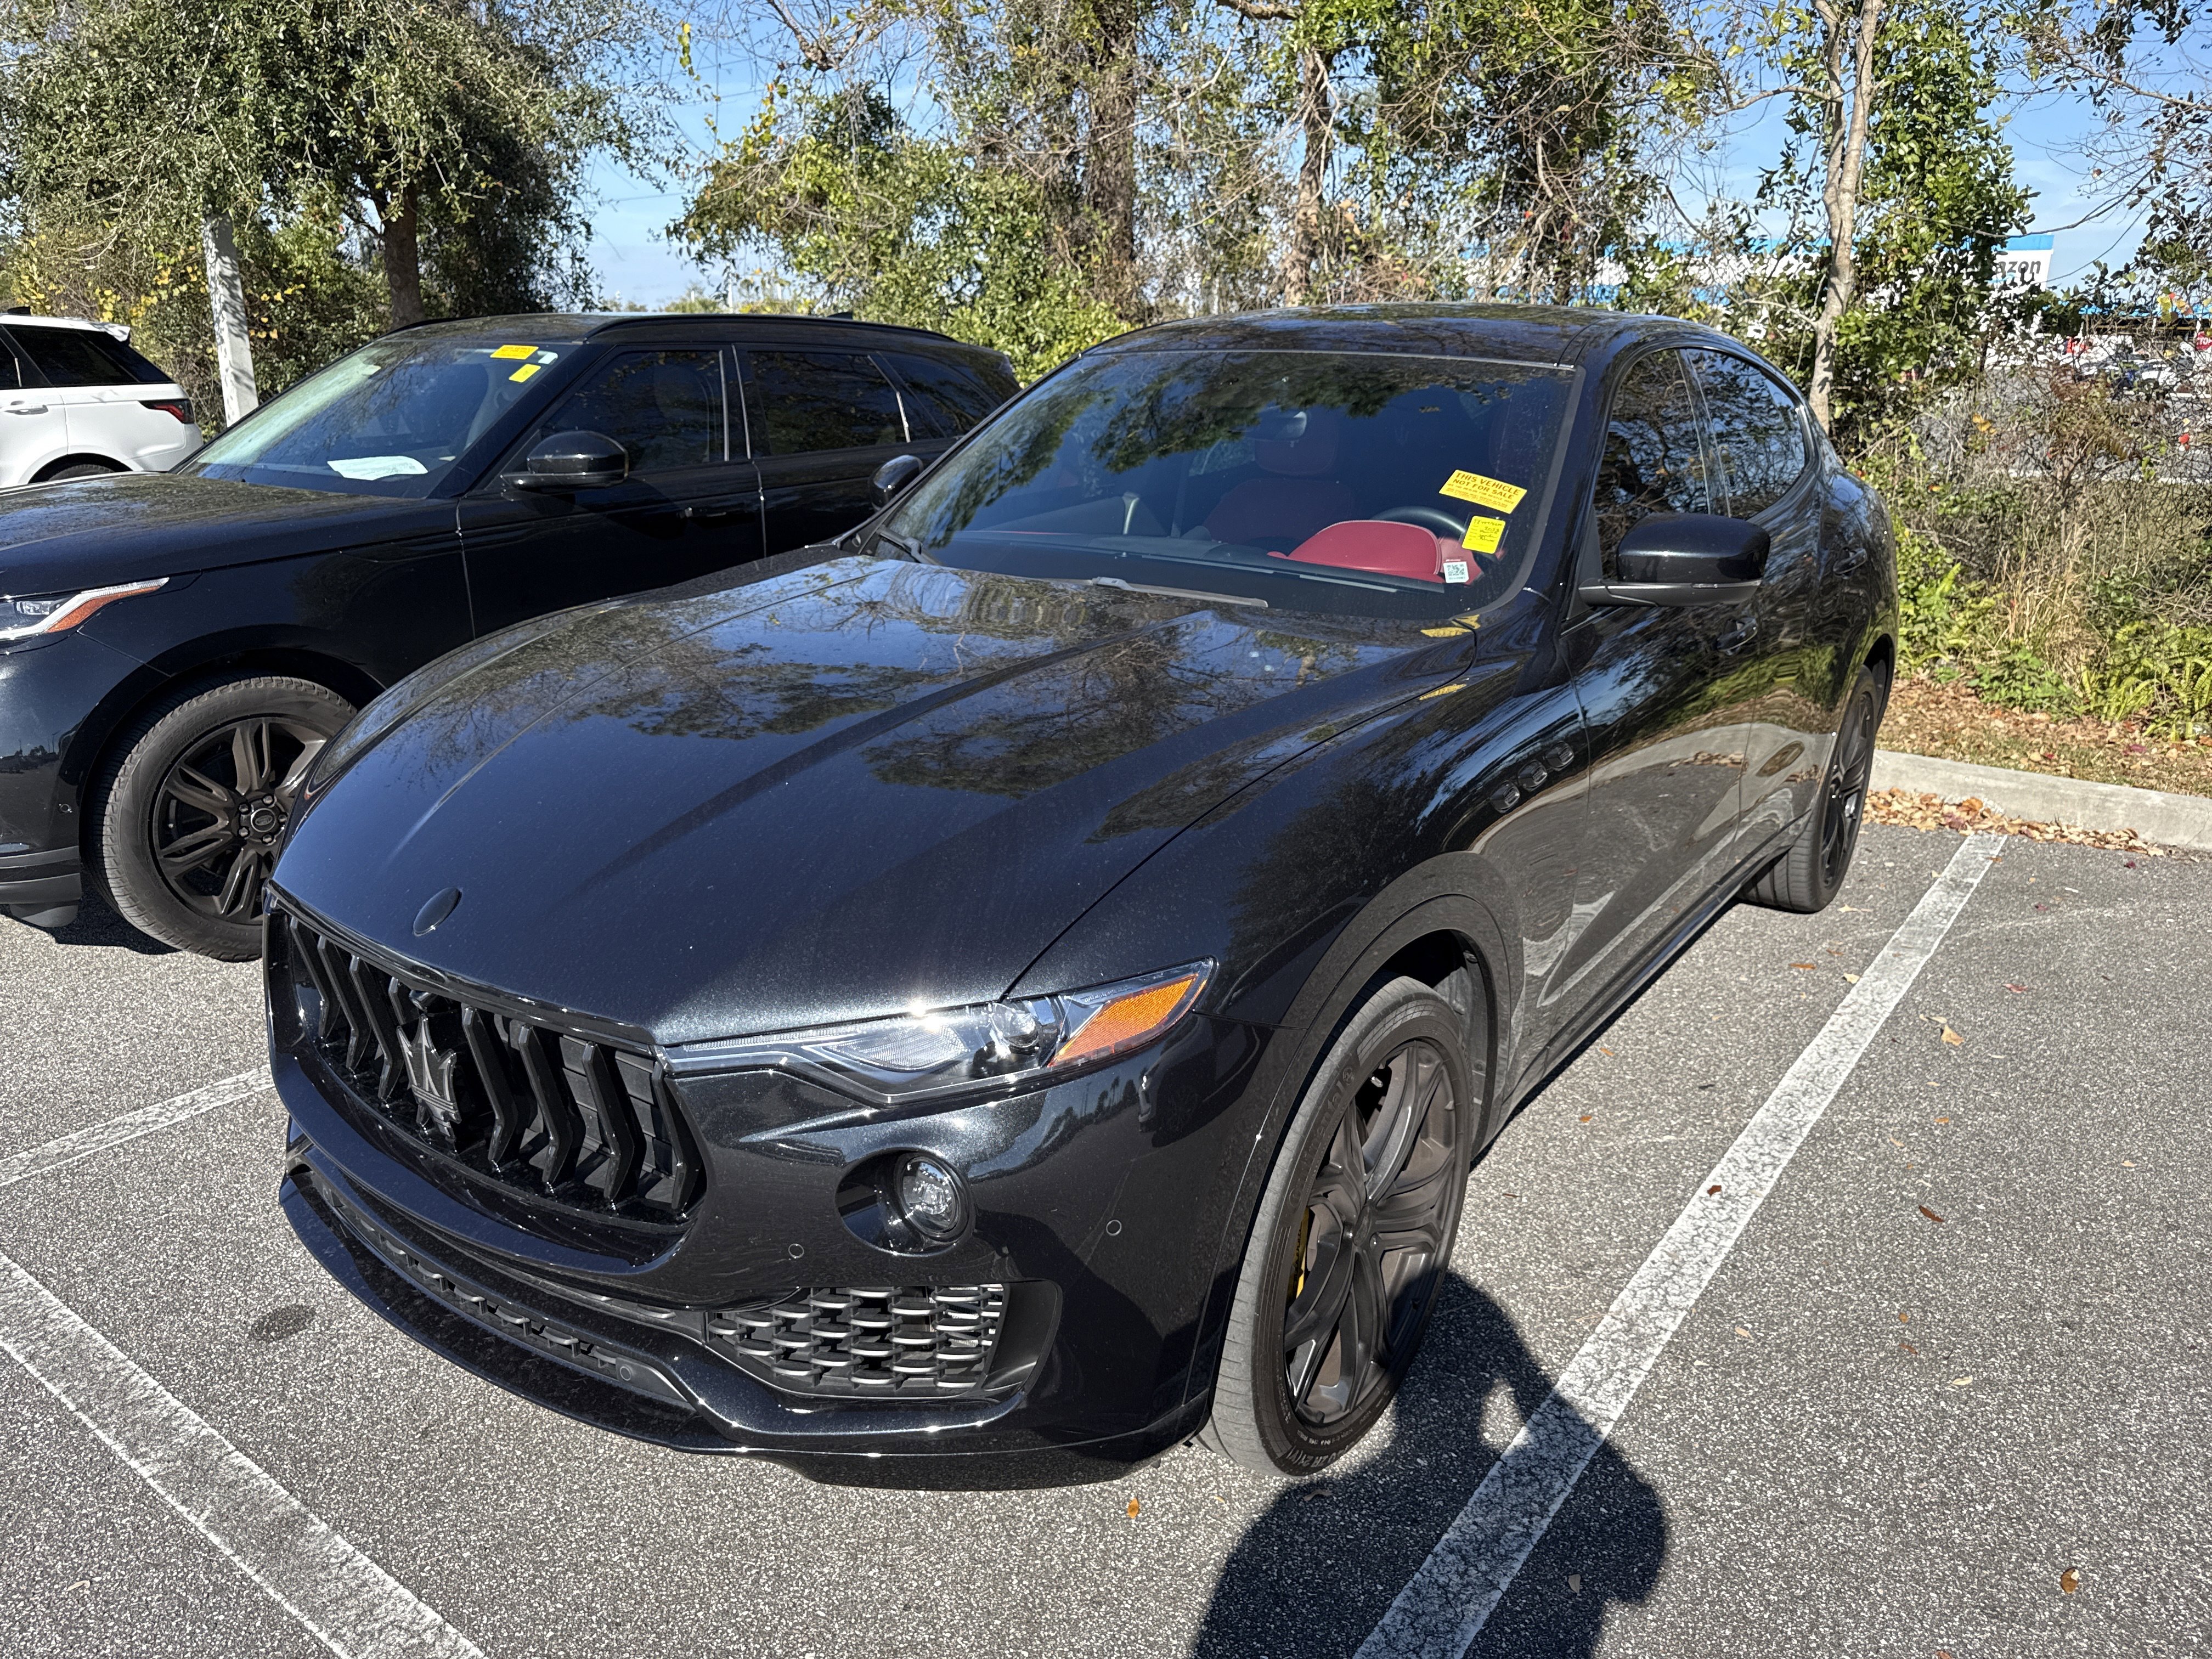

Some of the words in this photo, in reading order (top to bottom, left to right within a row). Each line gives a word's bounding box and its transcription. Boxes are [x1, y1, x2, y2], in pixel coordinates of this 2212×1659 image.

[1997, 261, 2041, 274] azon
[1456, 472, 1477, 482] THIS
[1481, 478, 1521, 495] VEHICLE
[1472, 483, 1490, 492] FOR
[1492, 489, 1514, 499] SALE
